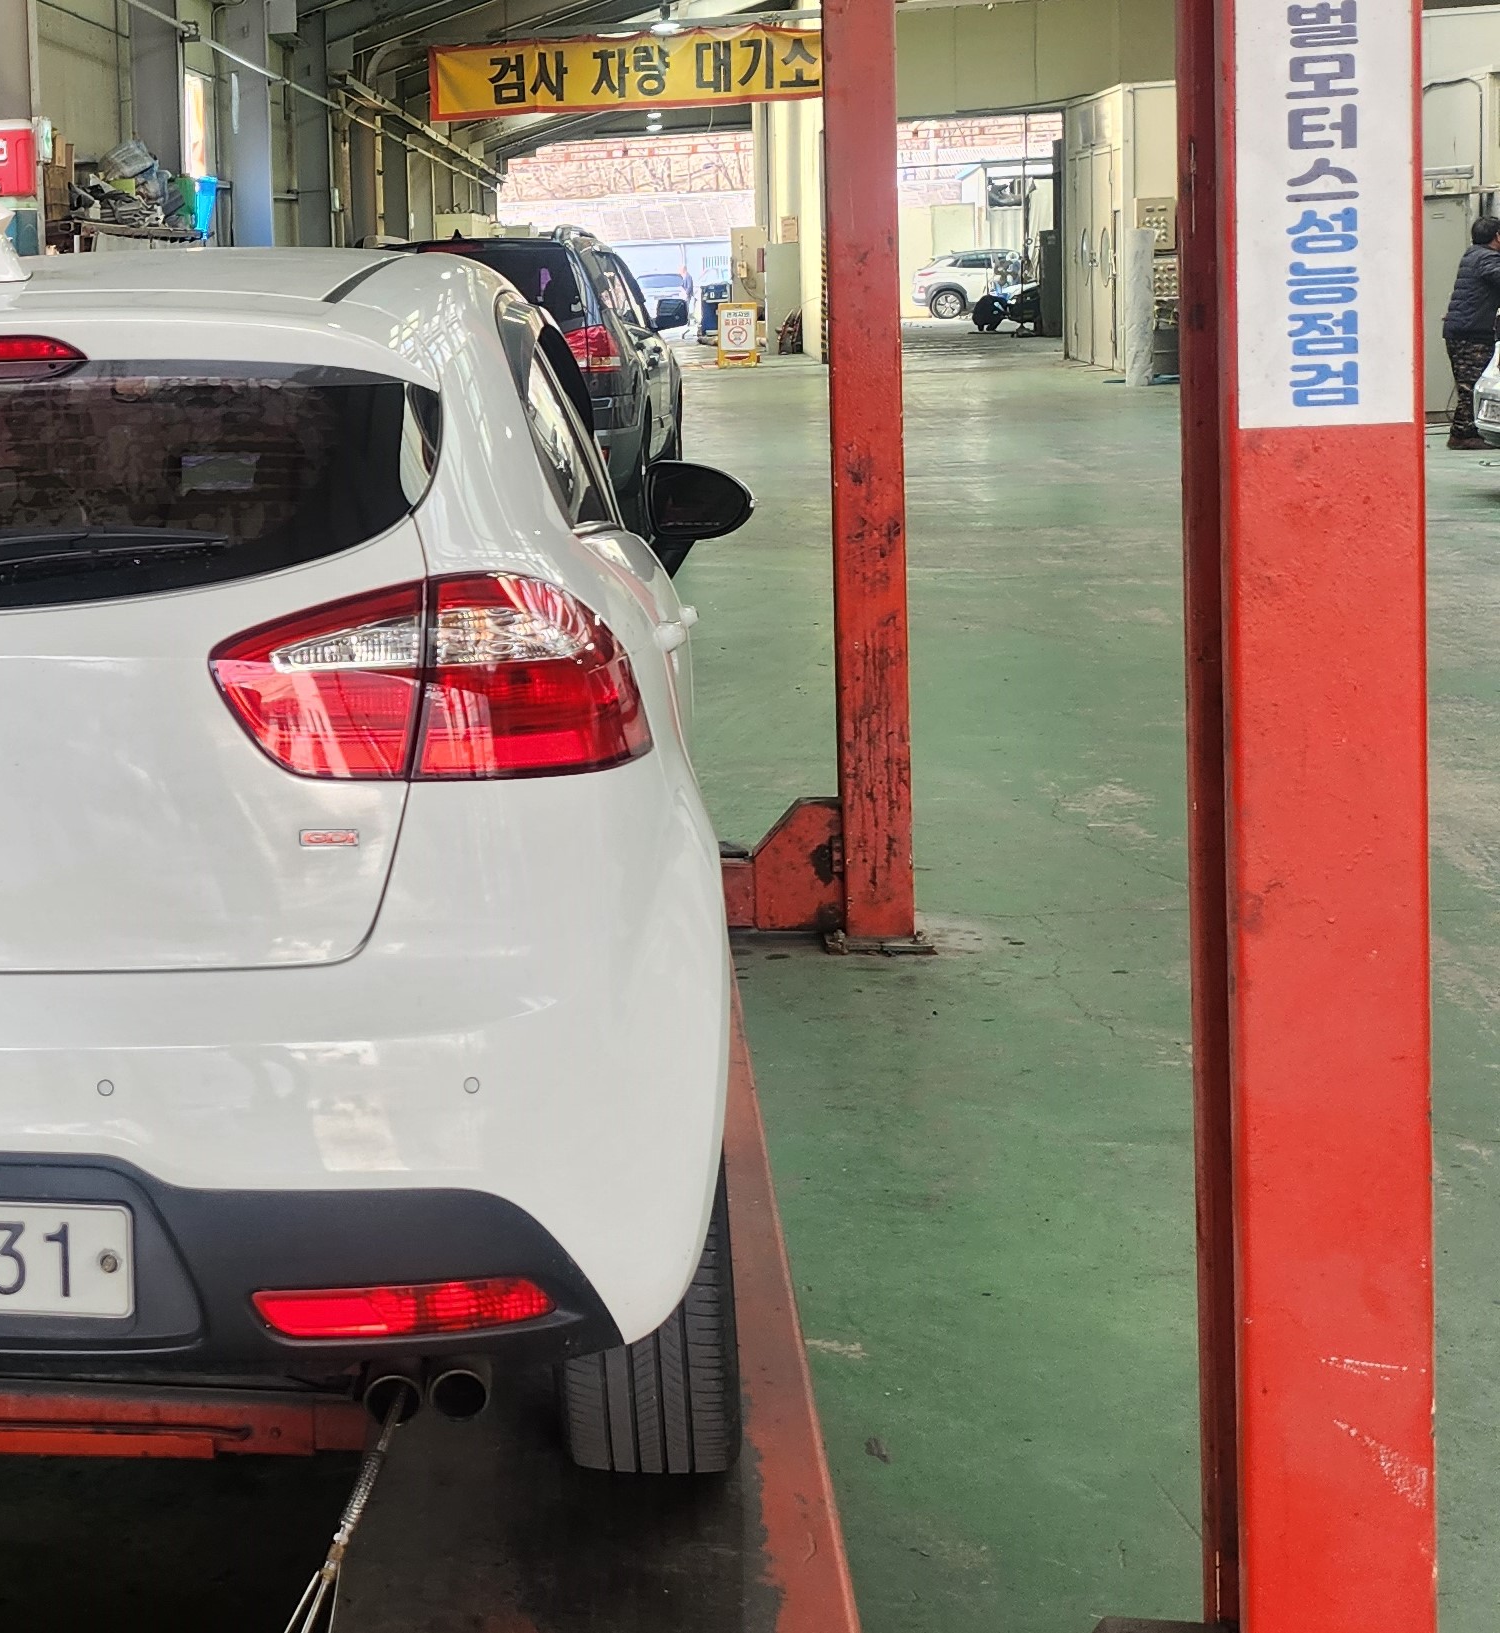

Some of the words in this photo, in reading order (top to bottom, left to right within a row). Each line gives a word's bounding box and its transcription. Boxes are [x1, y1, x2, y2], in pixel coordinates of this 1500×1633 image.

[488, 50, 568, 105] 검사
[591, 44, 670, 98] 차량
[695, 37, 820, 93] 대기소
